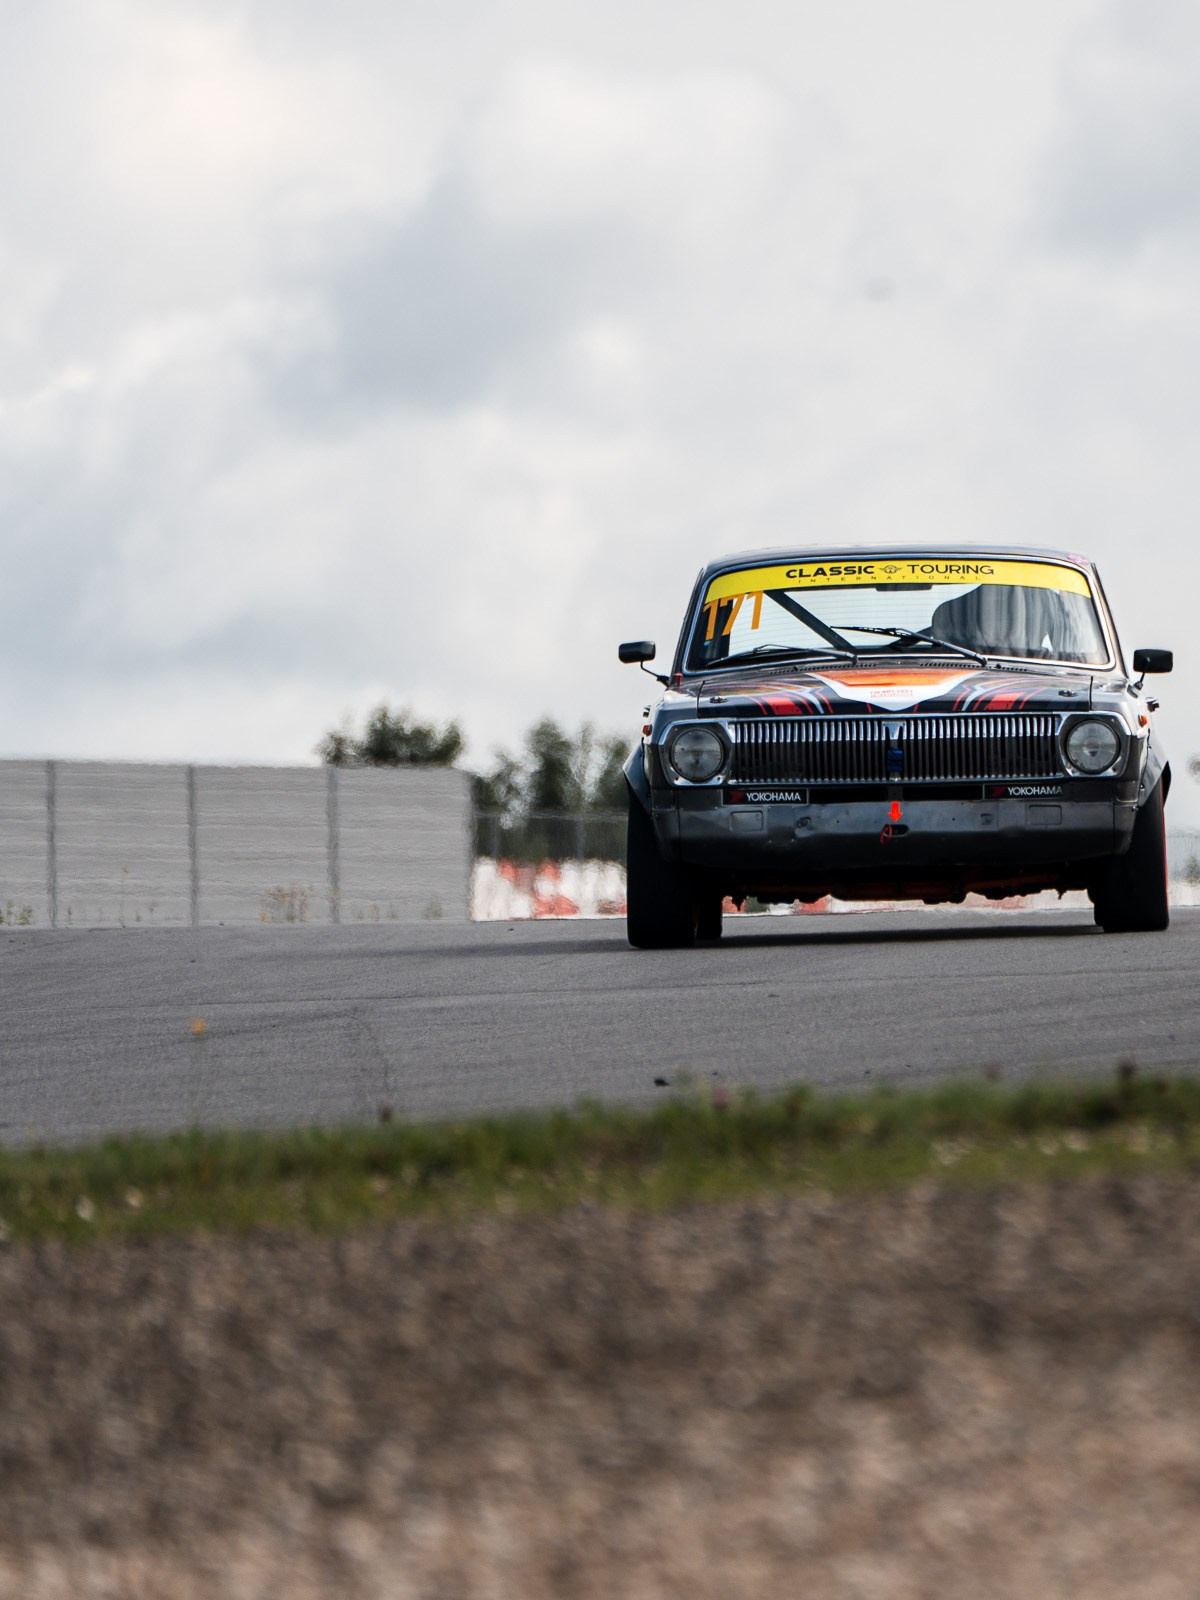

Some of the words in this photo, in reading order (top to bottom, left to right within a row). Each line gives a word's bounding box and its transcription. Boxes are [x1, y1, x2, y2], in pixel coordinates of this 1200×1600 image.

[785, 565, 875, 579] CLASSIC
[907, 564, 995, 576] TOURING
[702, 590, 763, 641] 171
[746, 792, 801, 802] YOKOHAMA
[1007, 785, 1064, 796] YOKOHAMA
